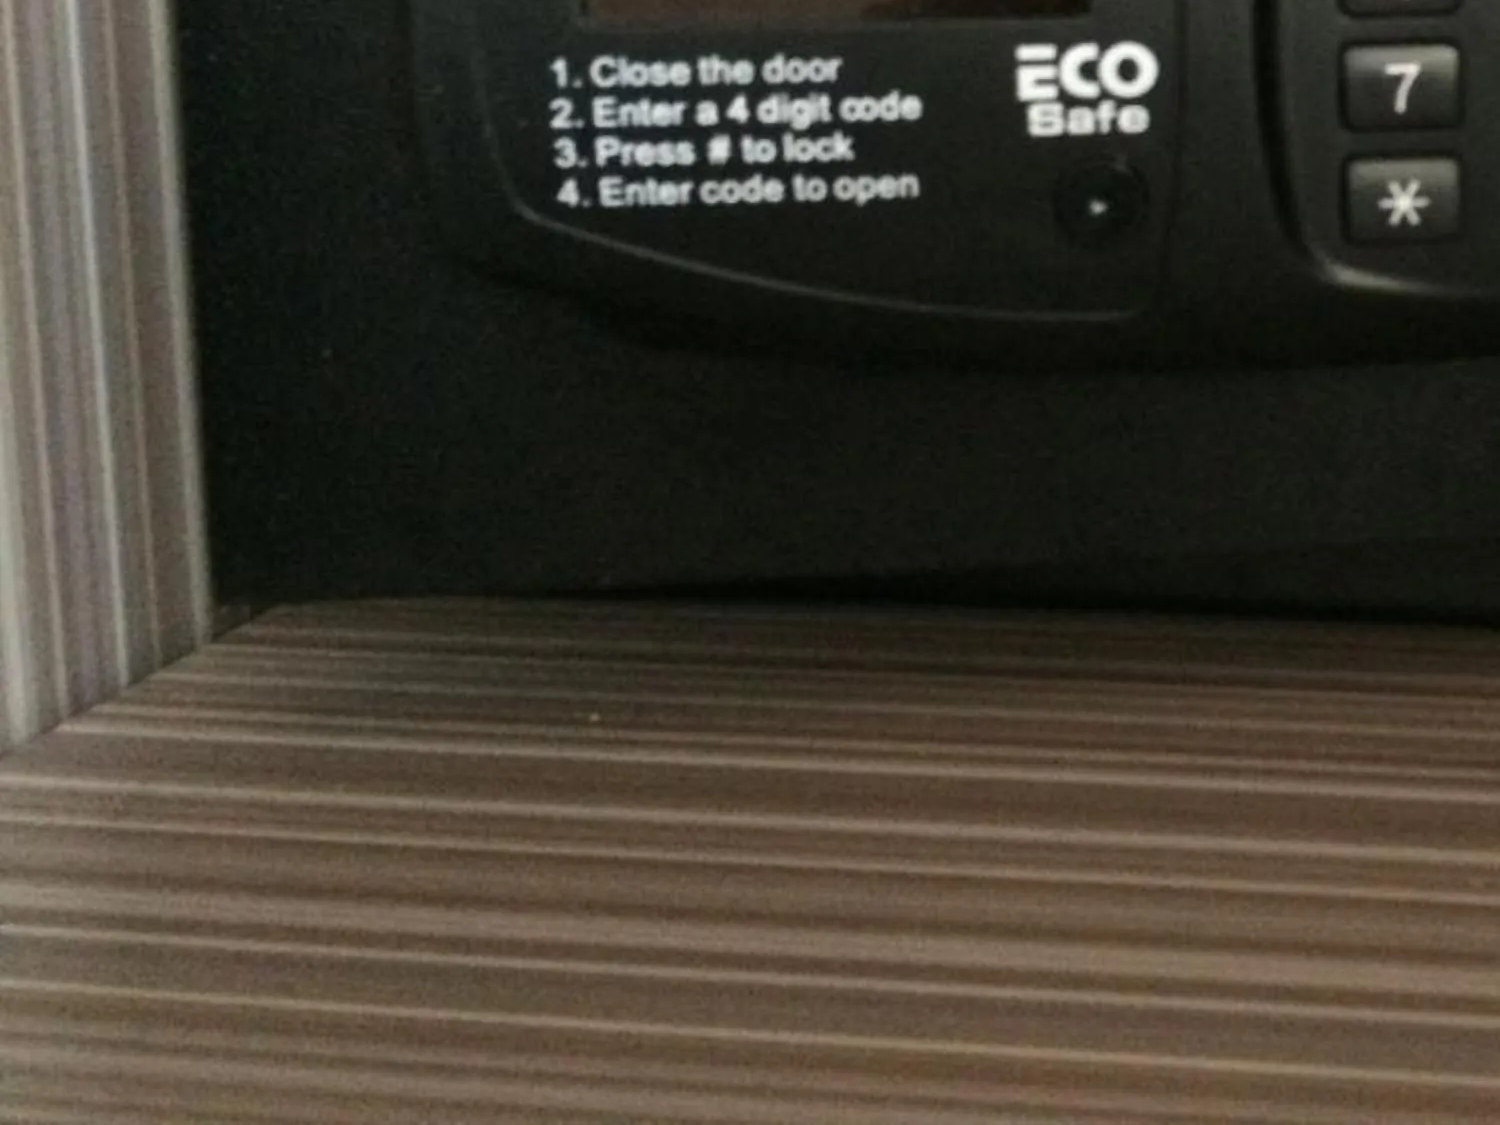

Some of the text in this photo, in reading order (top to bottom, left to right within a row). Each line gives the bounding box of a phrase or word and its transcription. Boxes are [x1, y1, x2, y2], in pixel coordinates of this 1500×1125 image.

[551, 54, 842, 89] 1. Close the door
[1014, 41, 1158, 101] ECO
[1384, 61, 1421, 113] 7
[550, 90, 923, 131] 2. Enter a 4 digit code
[1026, 101, 1150, 137] Safe
[554, 137, 587, 168] 3.
[594, 135, 696, 167] Press
[740, 135, 777, 164] to
[782, 132, 854, 163] lock
[557, 174, 919, 208] 4. Enter code to open
